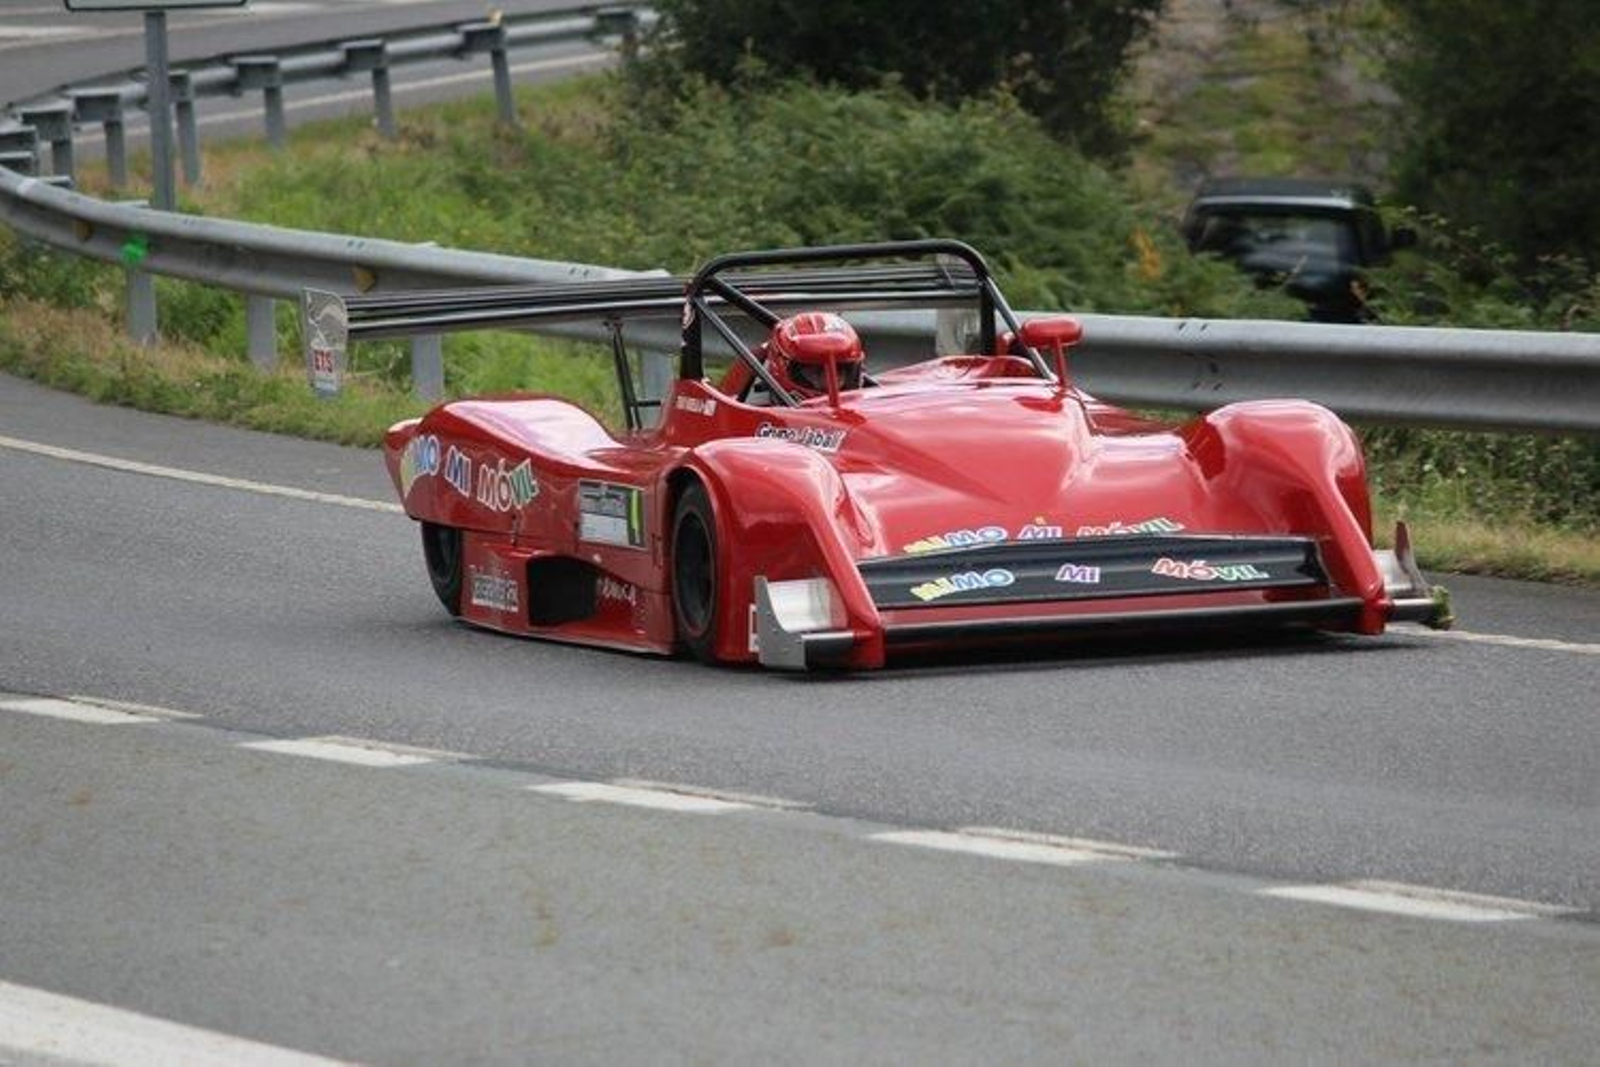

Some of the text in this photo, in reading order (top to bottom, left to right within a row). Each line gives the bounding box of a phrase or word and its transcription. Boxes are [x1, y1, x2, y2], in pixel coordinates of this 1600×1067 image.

[445, 445, 471, 499] MI
[1055, 563, 1100, 583] MI
[1151, 557, 1270, 581] MÓVIL
